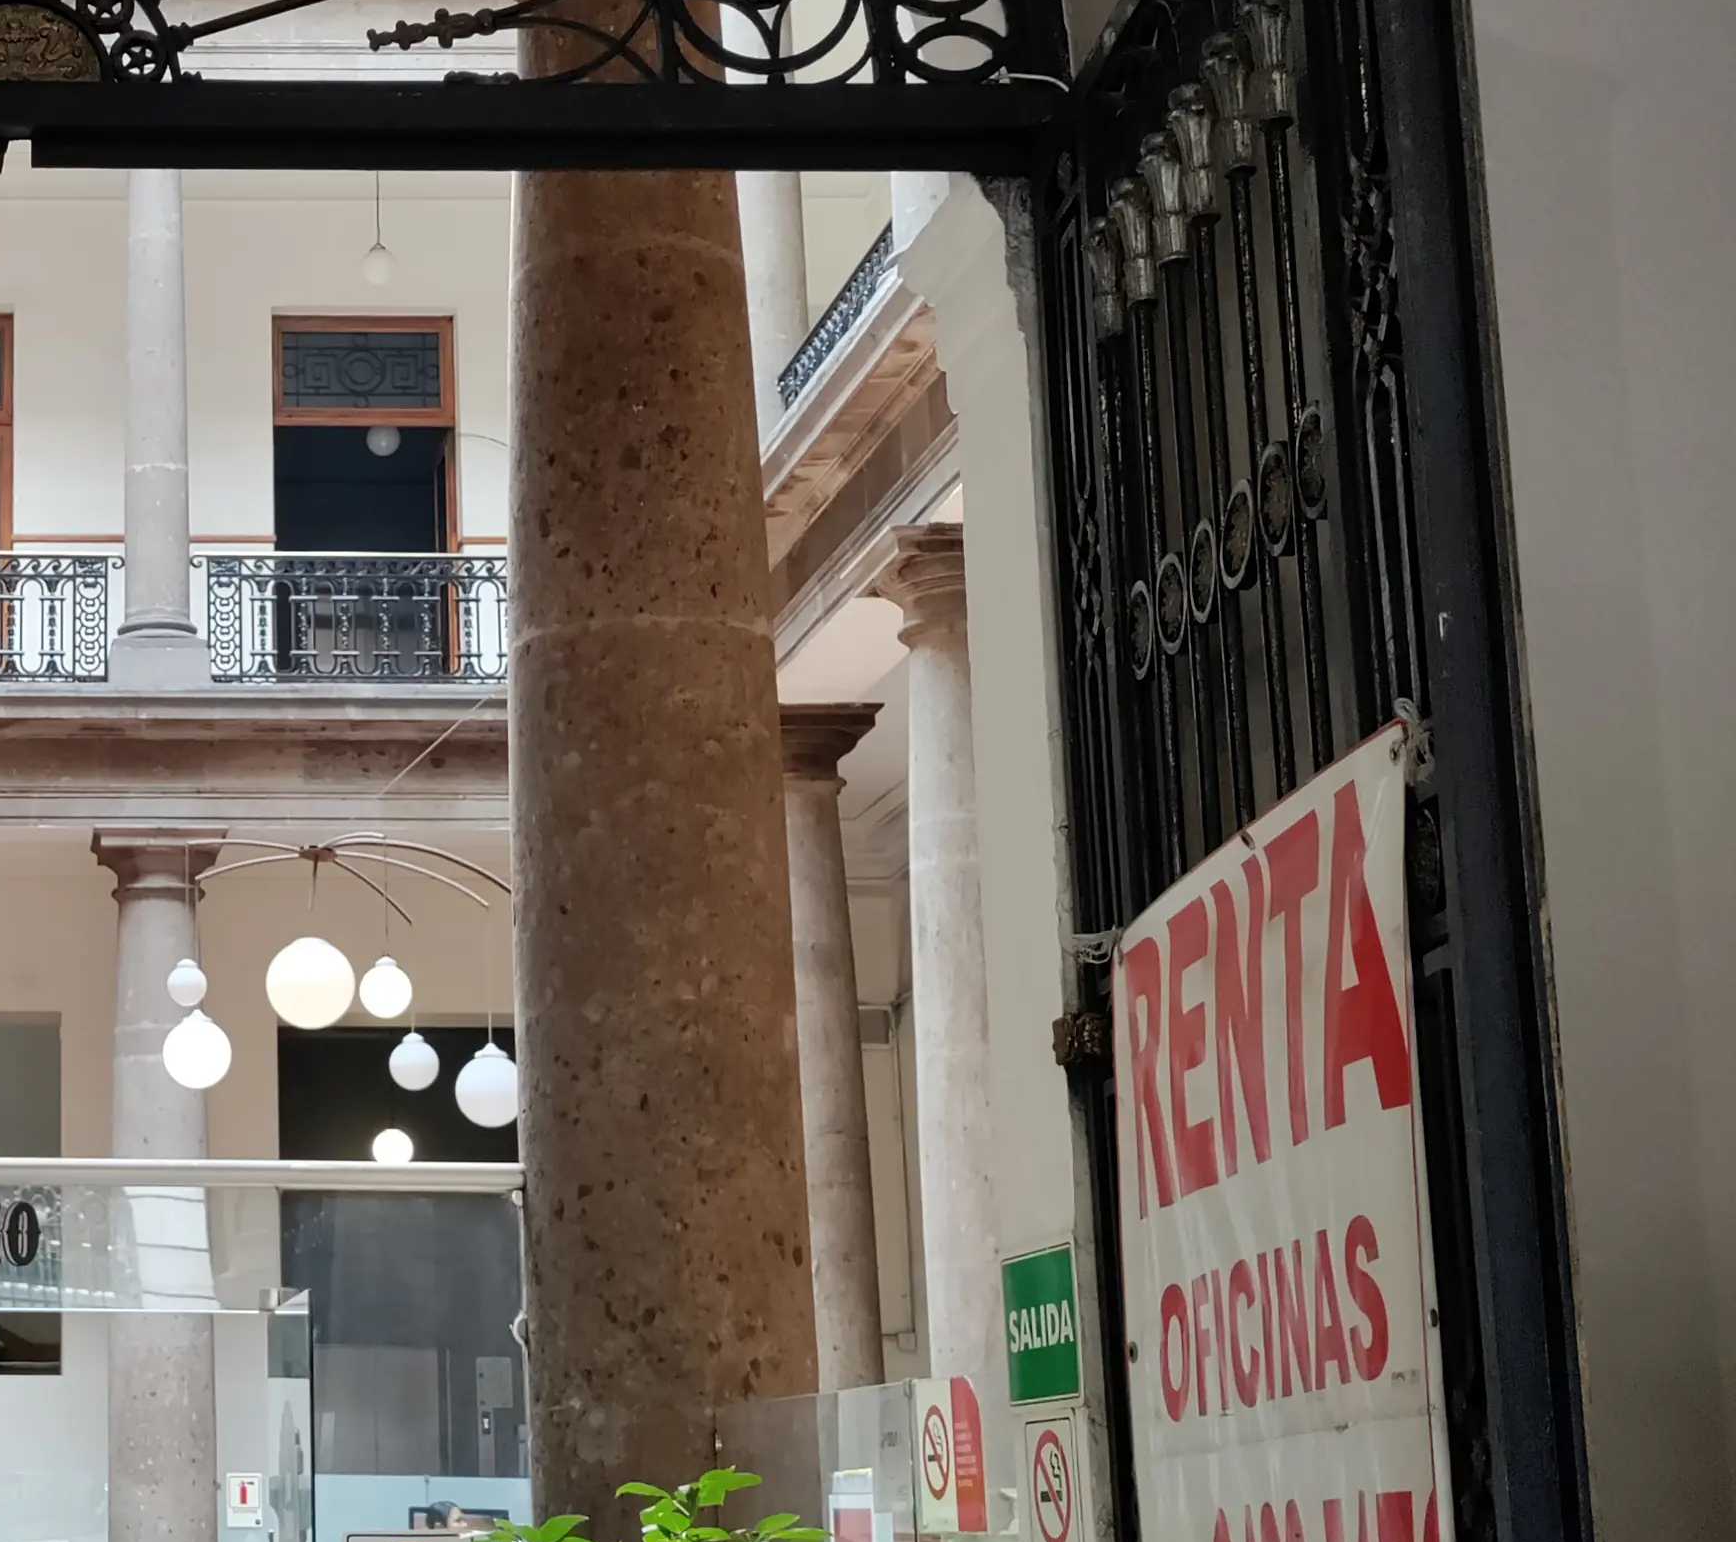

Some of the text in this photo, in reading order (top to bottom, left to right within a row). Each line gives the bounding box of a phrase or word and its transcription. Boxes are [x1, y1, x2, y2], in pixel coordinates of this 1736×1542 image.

[1123, 779, 1411, 1220] RENTA
[1008, 1299, 1075, 1354] SALIDA
[1160, 1214, 1389, 1423] OFICINAS
